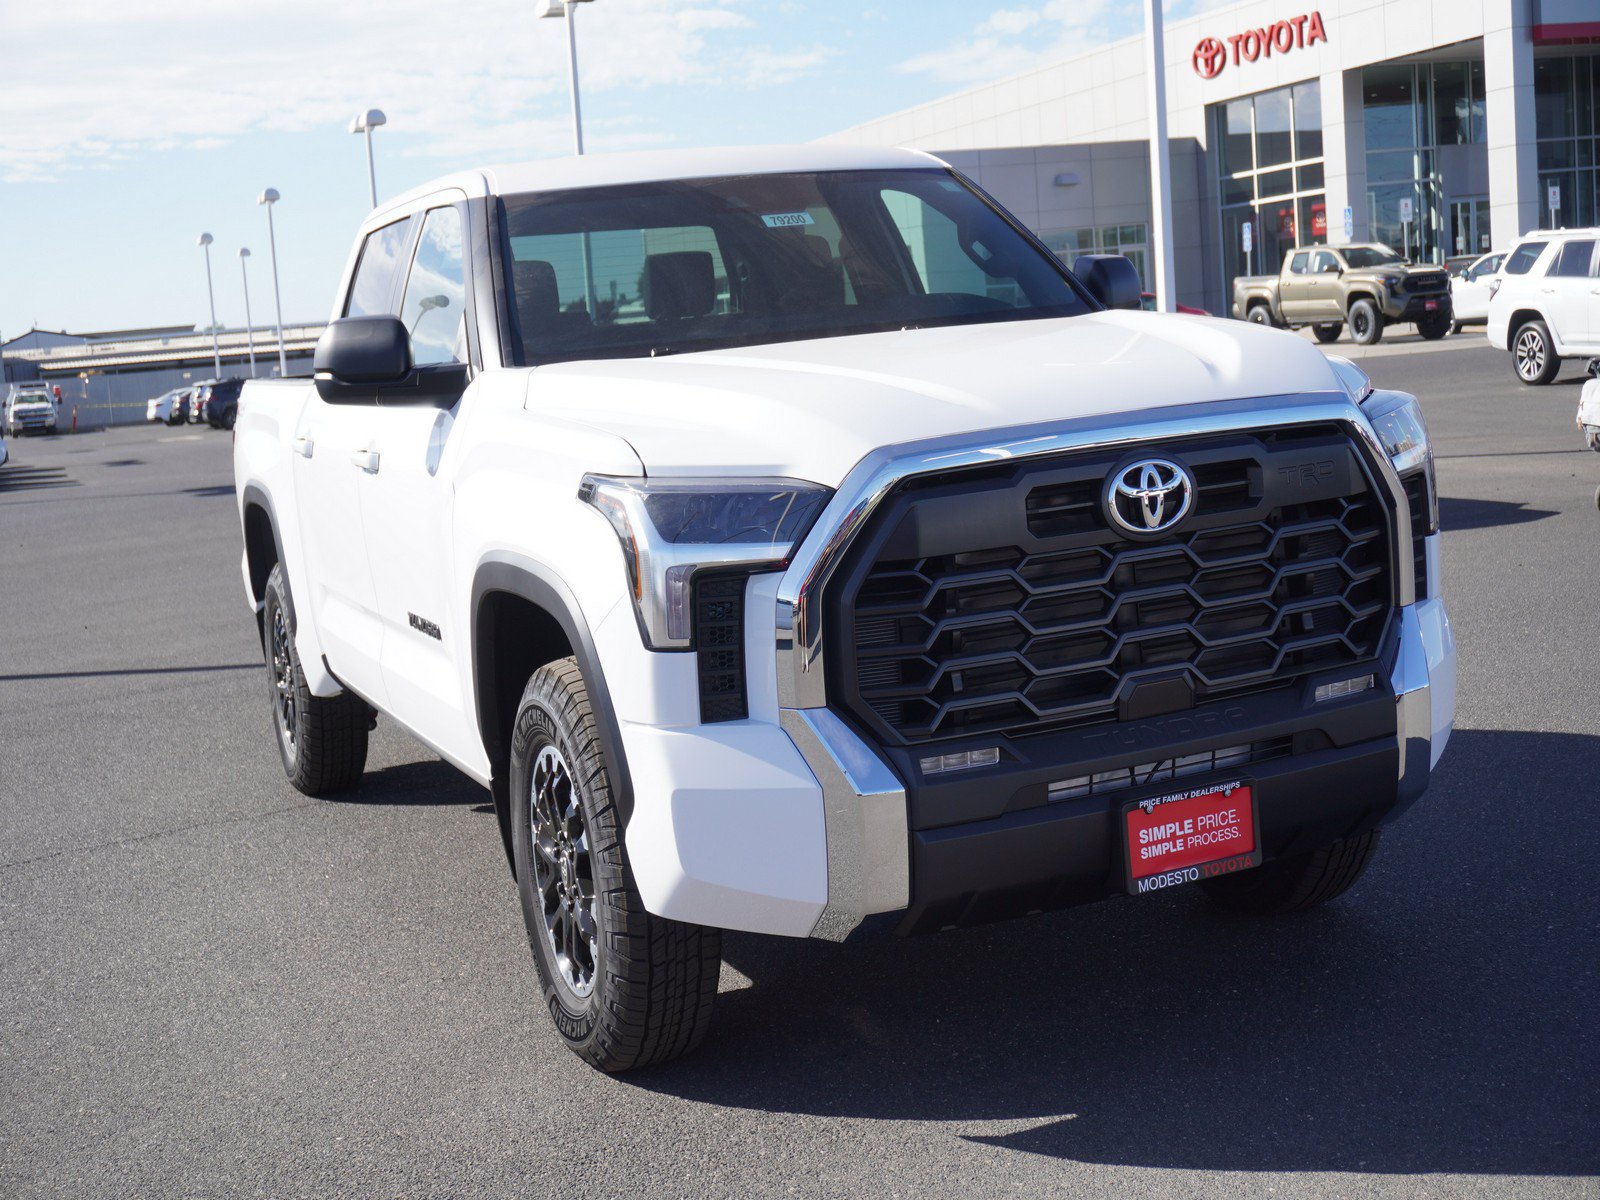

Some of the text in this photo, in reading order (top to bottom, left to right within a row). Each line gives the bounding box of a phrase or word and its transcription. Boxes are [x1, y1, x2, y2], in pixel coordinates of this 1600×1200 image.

[1227, 11, 1328, 66] TOYOTA
[769, 214, 806, 226] 79200
[1278, 460, 1336, 488] TRD
[520, 709, 556, 738] MICHELIN
[1082, 706, 1249, 750] TUNDRA
[1138, 781, 1241, 809] PRICE FAMILY DEALERSHIPS
[1139, 809, 1241, 844] SIMPLE PRICE.
[1140, 826, 1242, 860] SIMPLE PROCESS.
[1138, 855, 1253, 893] MODESTO TOYOTA
[551, 1001, 587, 1038] MICHELIN
